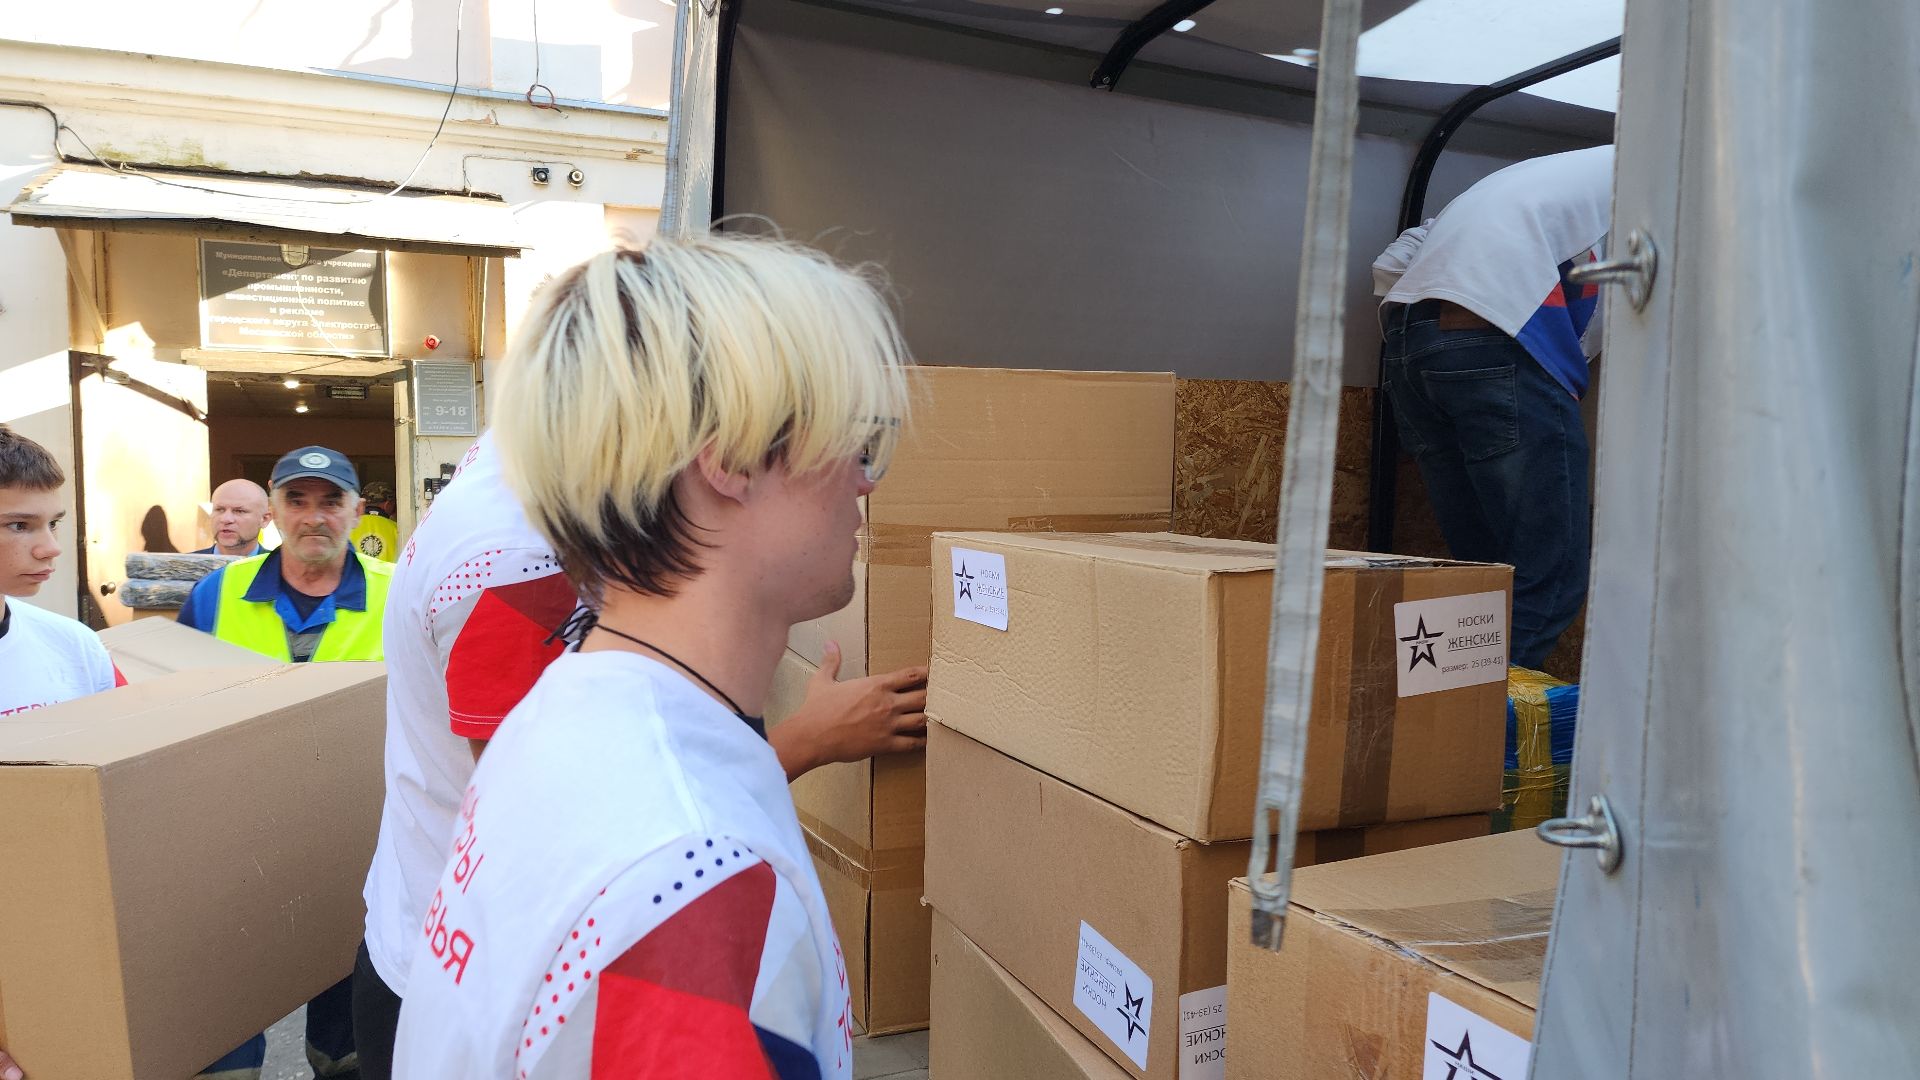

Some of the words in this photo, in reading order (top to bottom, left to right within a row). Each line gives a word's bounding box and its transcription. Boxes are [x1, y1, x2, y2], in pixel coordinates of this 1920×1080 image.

[323, 260, 372, 268] учреждение
[301, 274, 314, 282] по
[316, 275, 367, 285] развитию
[317, 298, 365, 307] политике
[1457, 613, 1494, 628] НОСКИ
[1447, 631, 1502, 650] ЖЕНСКИЕ
[1186, 1027, 1226, 1047] НСКИЕ
